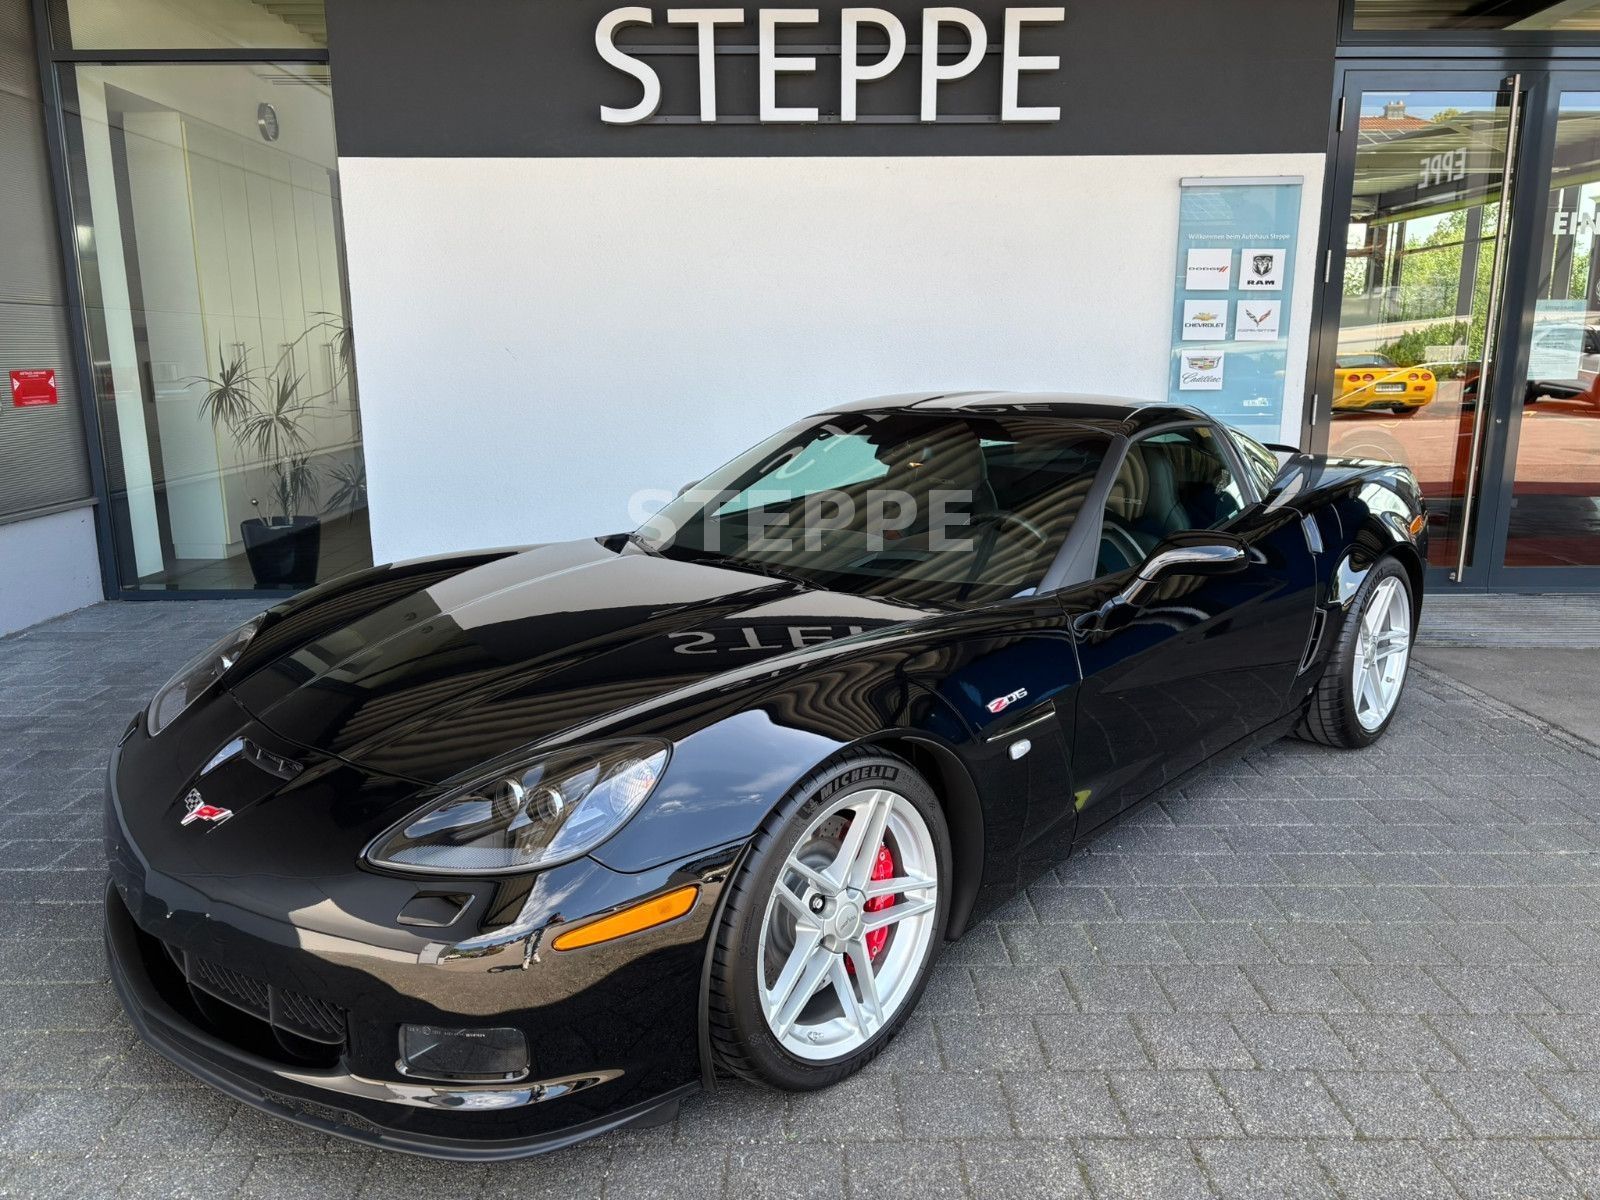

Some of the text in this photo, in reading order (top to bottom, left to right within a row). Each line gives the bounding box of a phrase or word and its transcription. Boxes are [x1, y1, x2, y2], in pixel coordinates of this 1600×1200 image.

[594, 6, 1065, 124] STEPPE
[1270, 233, 1290, 241] Steppe
[1181, 372, 1222, 384] Cadillac
[820, 766, 896, 799] MICHELIN
